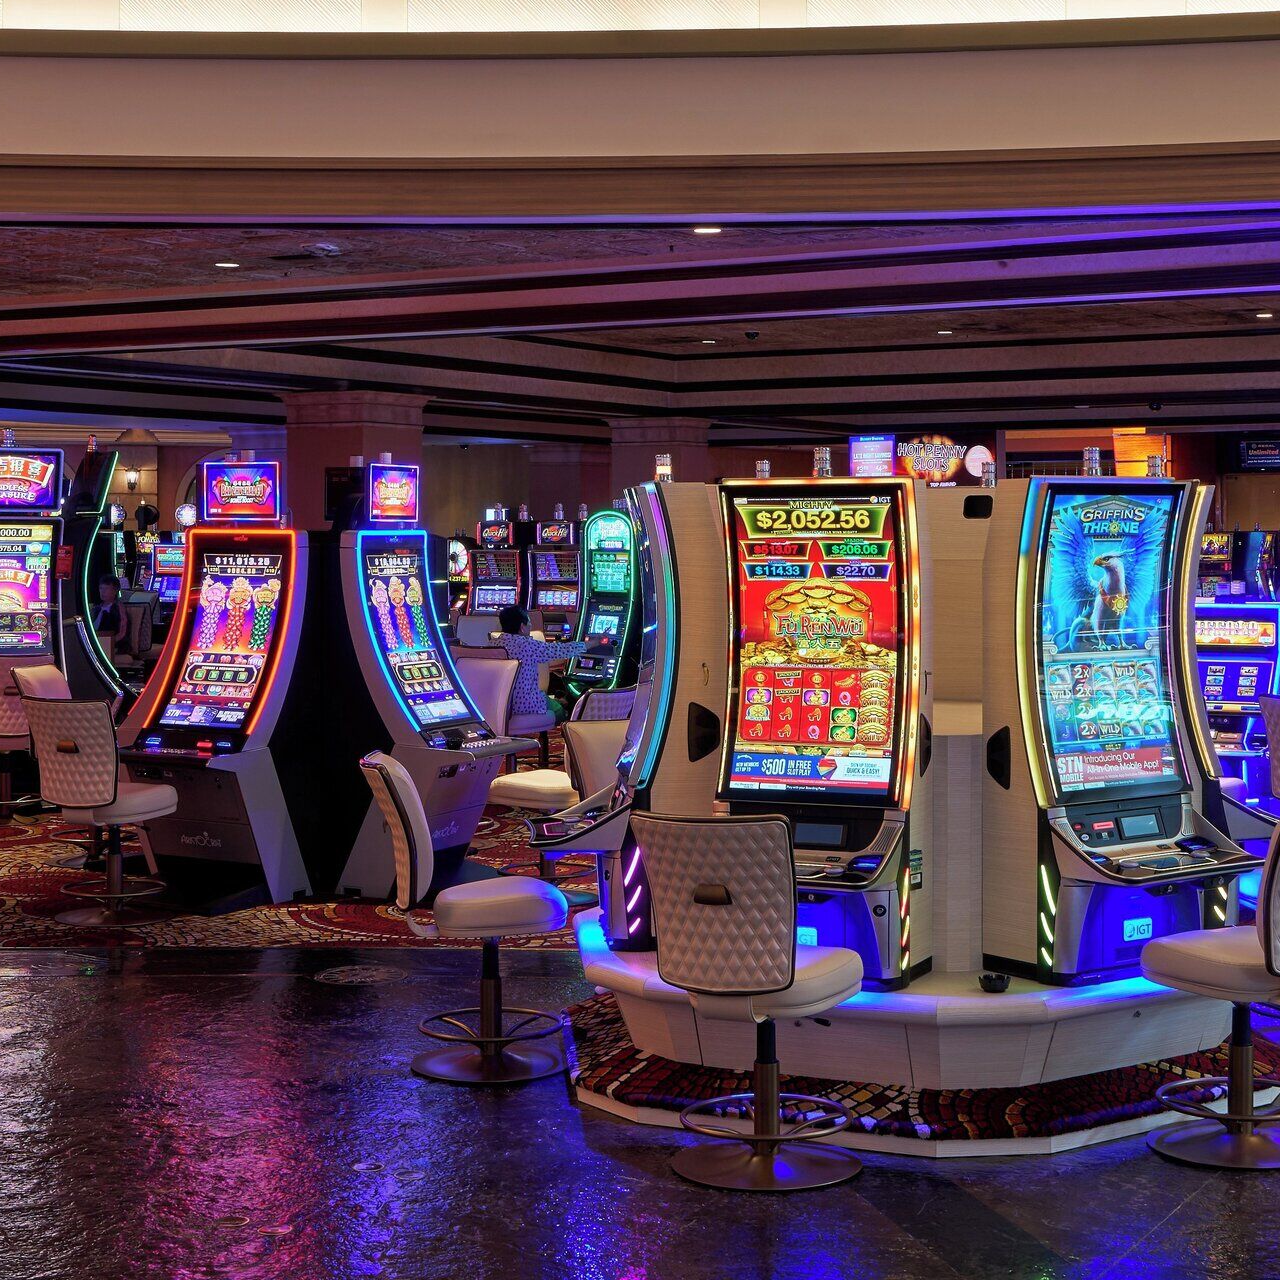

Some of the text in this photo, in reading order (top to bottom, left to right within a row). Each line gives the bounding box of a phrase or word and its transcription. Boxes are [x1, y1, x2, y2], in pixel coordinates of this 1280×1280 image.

[897, 442, 967, 459] HOT PENNY
[913, 457, 950, 471] SLOTS
[789, 500, 833, 509] MIGHTY
[756, 509, 870, 531] $2,052.56
[1083, 520, 1140, 535] THRONE
[754, 545, 799, 555] $513.07
[831, 545, 878, 555] $206.06
[755, 566, 800, 576] $114.33
[836, 566, 876, 576] $22.70
[1115, 667, 1135, 677] WILD
[1051, 690, 1071, 700] WILD
[1100, 725, 1120, 735] WILD
[1084, 752, 1135, 764] Introducing Our
[761, 758, 786, 775] $500
[788, 760, 812, 769] IN FREE
[1057, 756, 1083, 774] STN
[1120, 761, 1142, 771] Mobile
[1143, 760, 1160, 769] App!
[1060, 772, 1084, 783] MOBILE
[1136, 924, 1152, 936] IGT
[799, 934, 816, 944] GT
